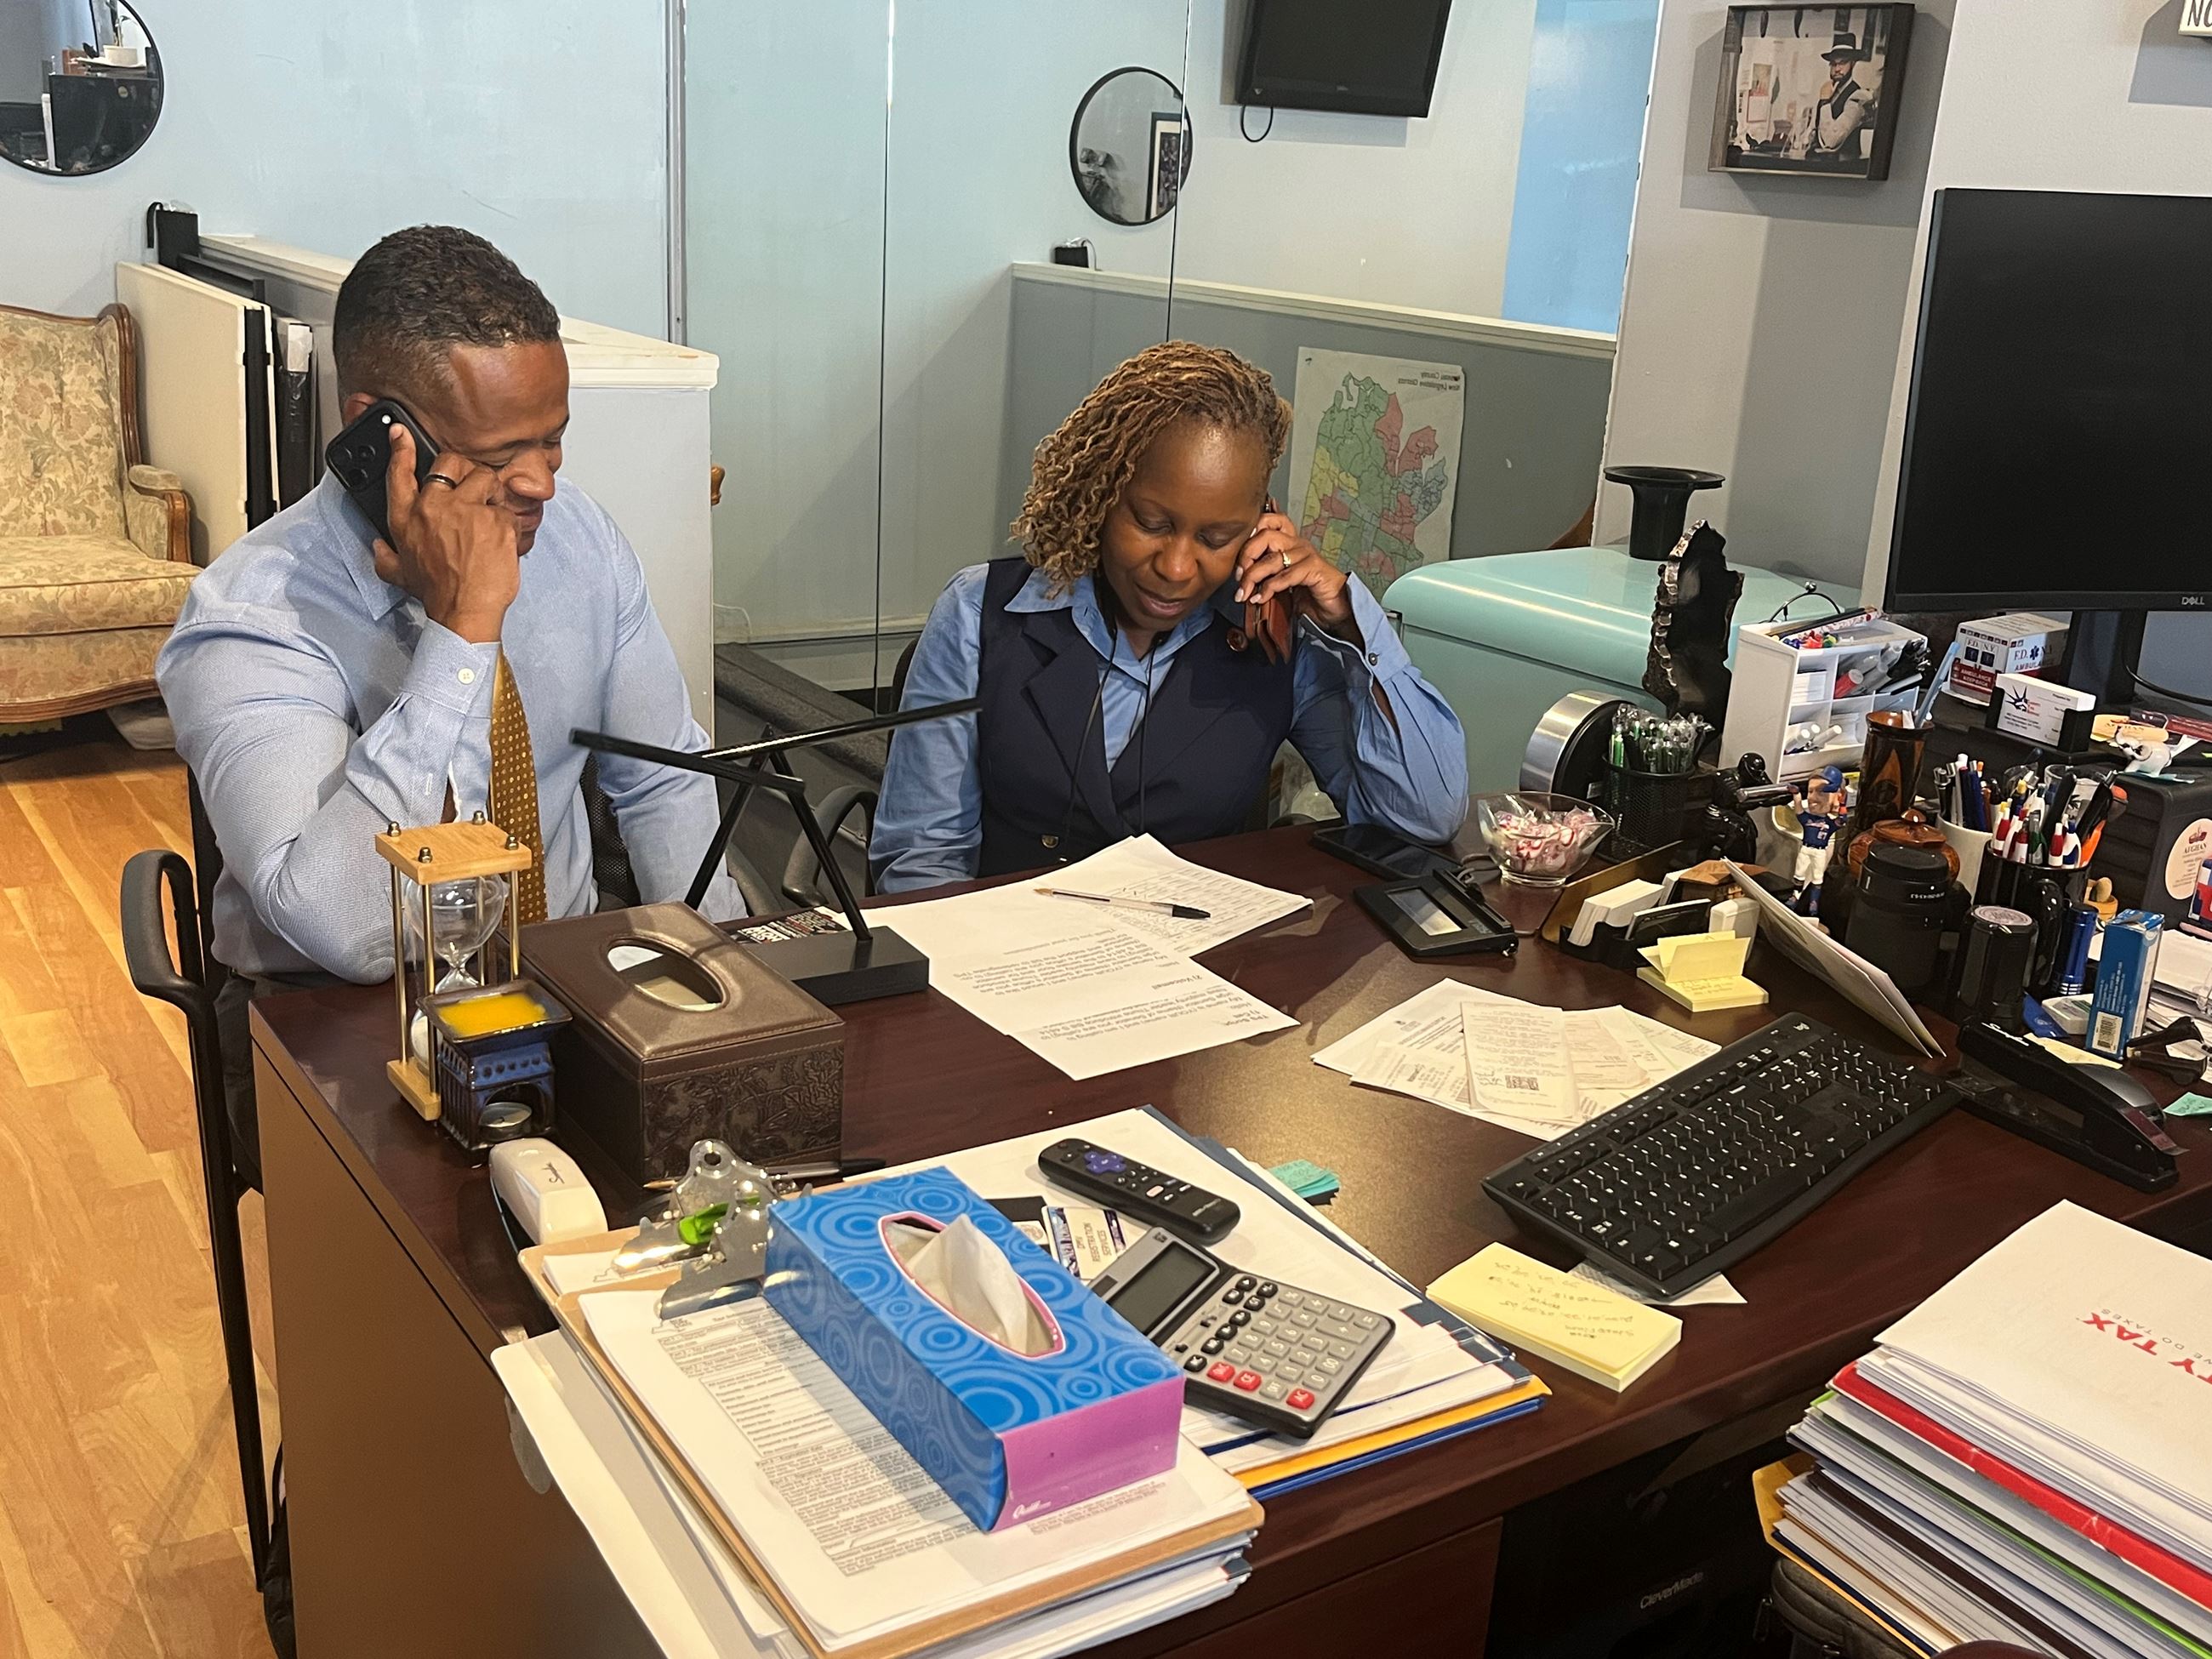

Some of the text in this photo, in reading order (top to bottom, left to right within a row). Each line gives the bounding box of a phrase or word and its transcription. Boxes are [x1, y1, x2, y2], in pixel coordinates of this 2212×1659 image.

[2181, 596, 2205, 606] DELL
[1082, 1223, 1100, 1261] REGISTRATION
[2101, 1308, 2152, 1335] TAXES
[1285, 1328, 1297, 1337] 6
[2082, 1312, 2158, 1356] TAX
[1273, 1341, 1285, 1350] 5
[2162, 1337, 2185, 1350] DO
[1232, 1348, 1244, 1357] 7
[1298, 1351, 1311, 1360] 2
[1260, 1357, 1272, 1365] 4
[1294, 1390, 1308, 1402] AC
[1640, 1572, 1703, 1610] CleverMade
